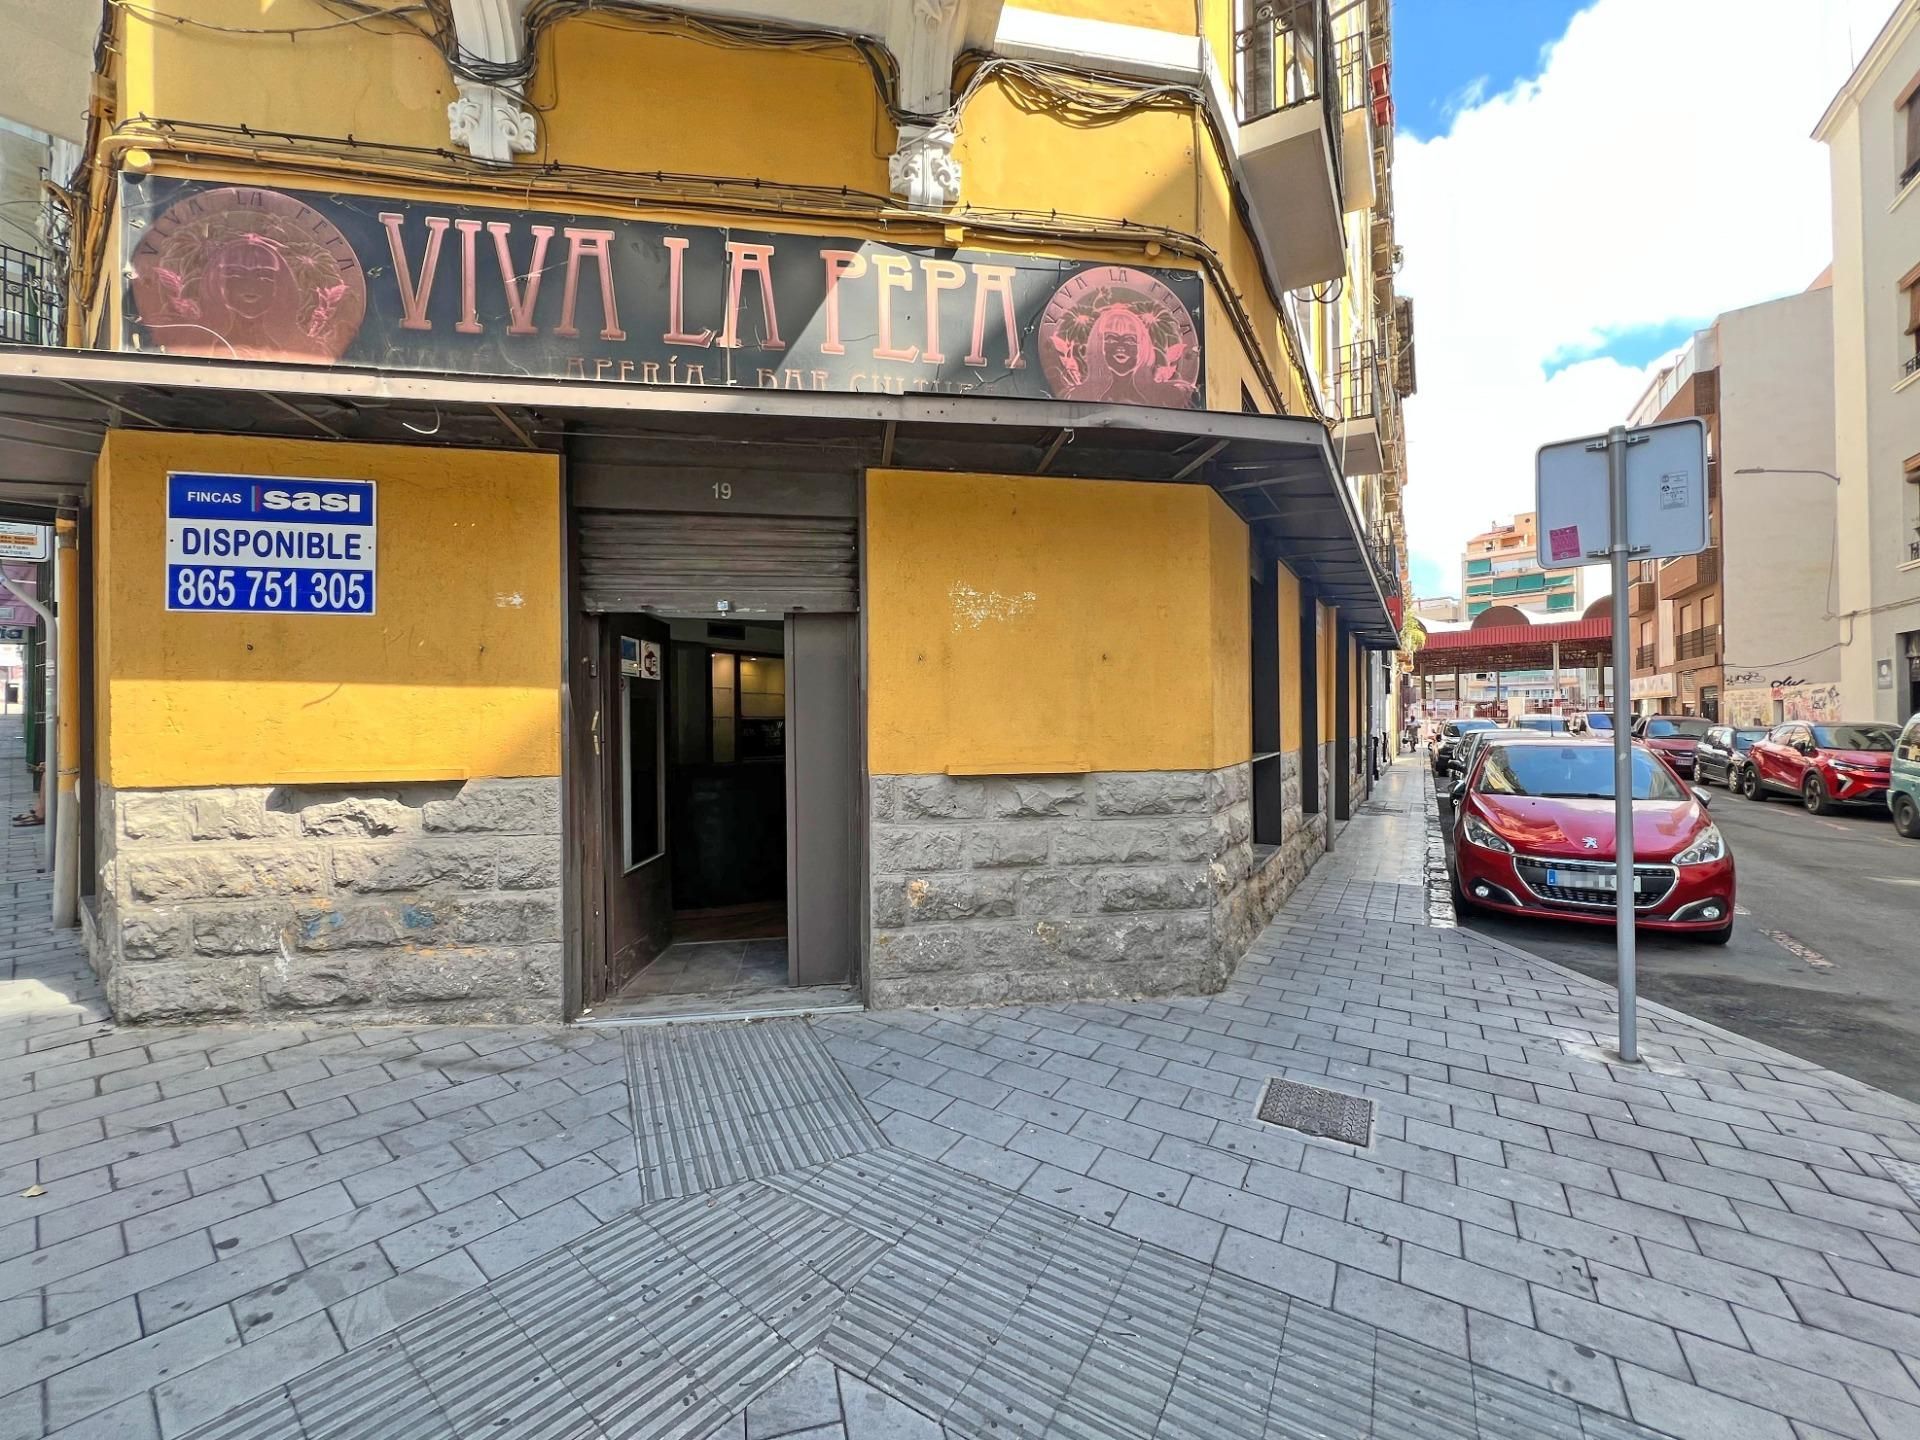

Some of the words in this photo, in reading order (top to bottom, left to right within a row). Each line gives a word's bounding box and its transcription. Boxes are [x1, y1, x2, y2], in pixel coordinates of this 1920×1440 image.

[141, 199, 205, 256] VIVA
[236, 190, 263, 207] LA
[295, 206, 355, 271] PEPA
[378, 211, 627, 342] VIVA
[662, 236, 786, 352] LA
[819, 248, 1028, 370] PEPA
[1044, 277, 1088, 325] VIVA
[1109, 268, 1128, 283] LA
[1150, 280, 1192, 336] PEPA
[187, 491, 242, 504] FINCAS
[711, 482, 732, 500] 19
[182, 527, 362, 561] DISPONIBLE
[177, 568, 236, 607] 865
[246, 570, 298, 609] 751
[310, 572, 366, 610] 305
